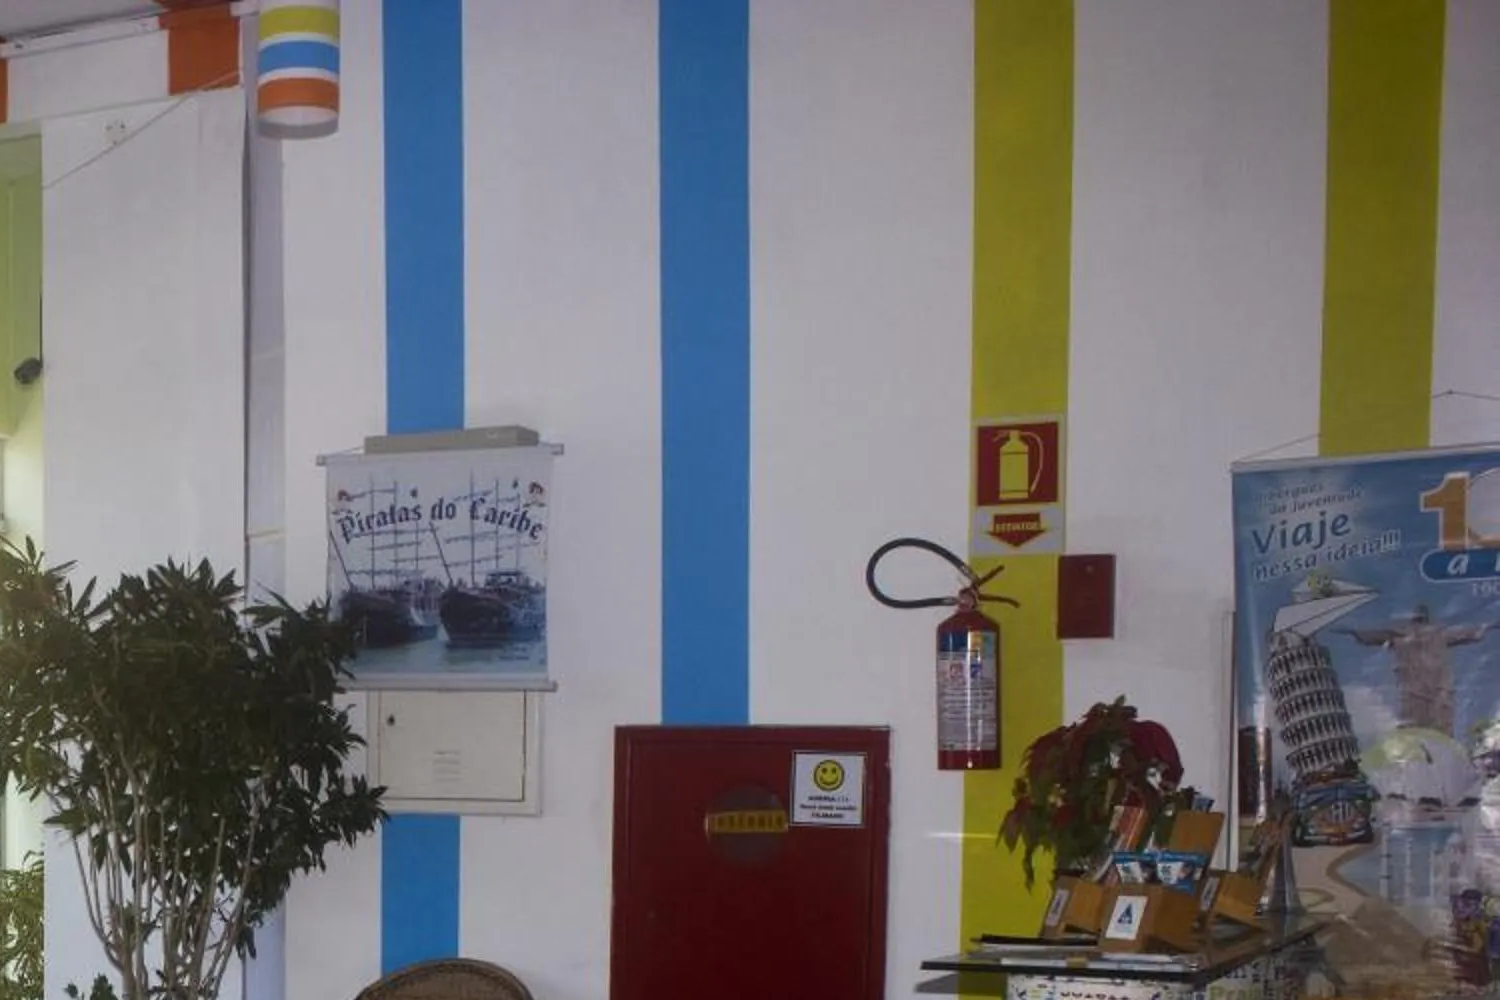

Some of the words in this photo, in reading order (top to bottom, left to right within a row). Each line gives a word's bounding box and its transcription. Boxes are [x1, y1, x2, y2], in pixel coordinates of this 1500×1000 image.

[337, 503, 423, 543] Piratas
[430, 498, 457, 521] do
[469, 497, 545, 540] Caribe
[1252, 511, 1351, 554] Viaje
[1255, 553, 1318, 579] nessa
